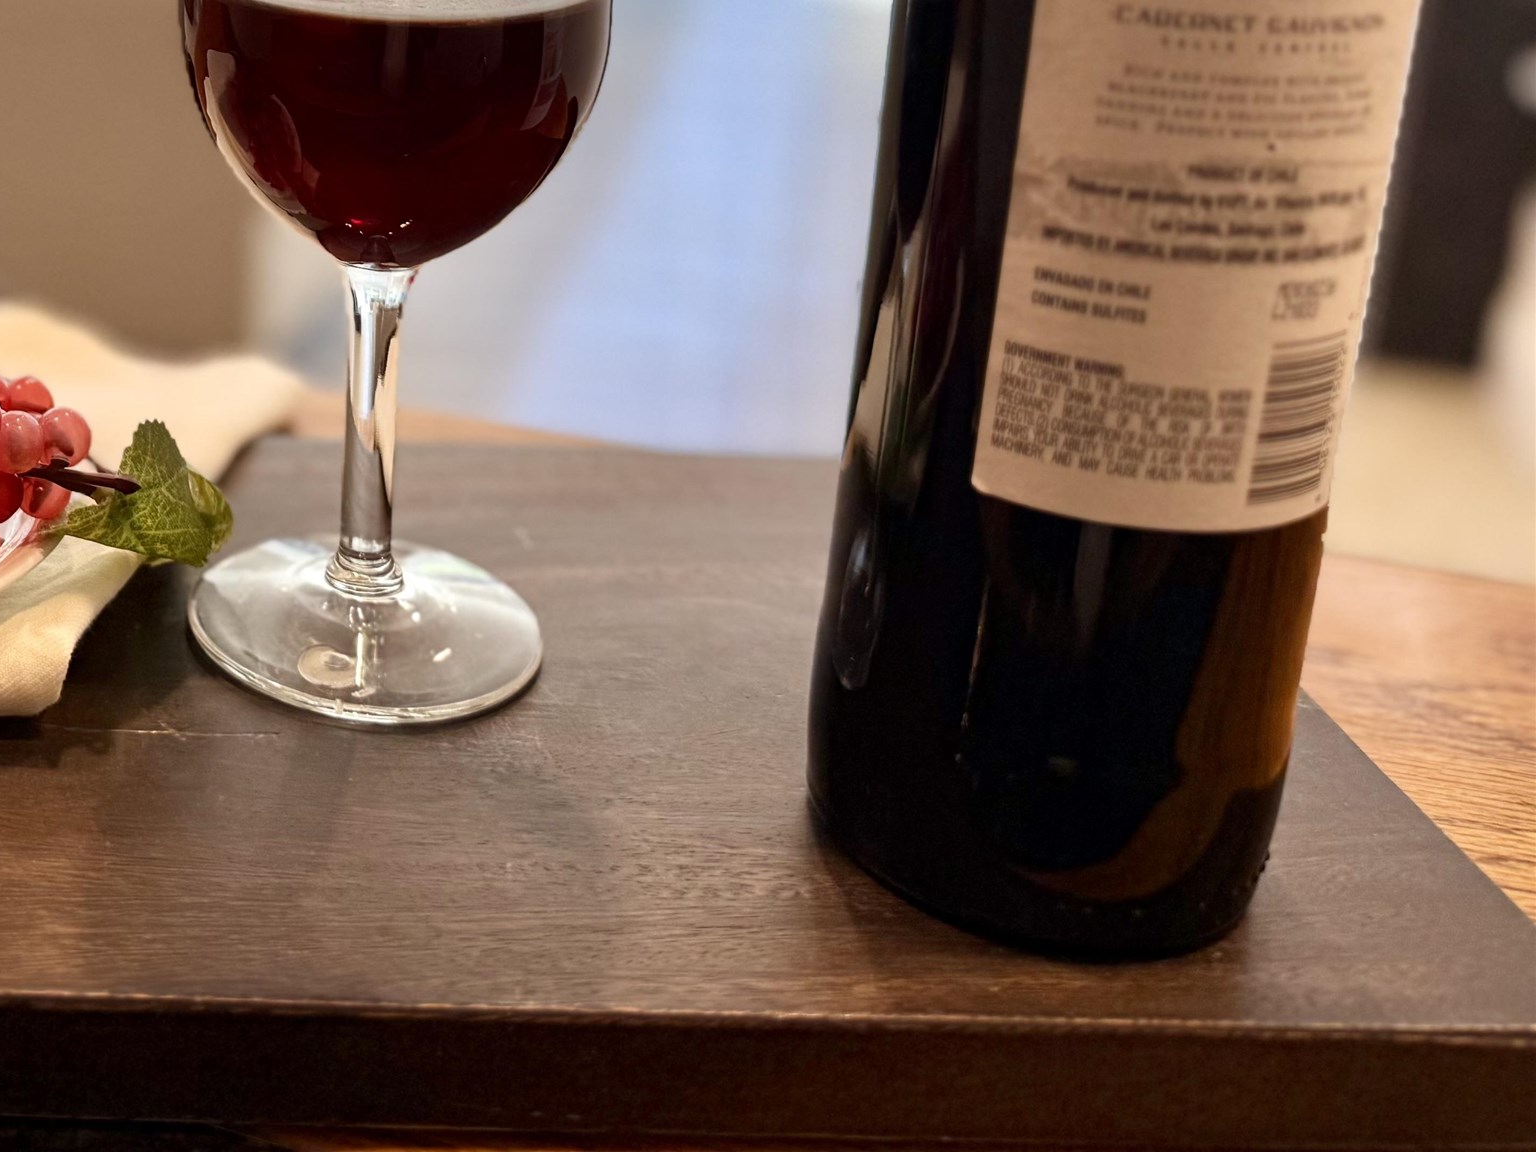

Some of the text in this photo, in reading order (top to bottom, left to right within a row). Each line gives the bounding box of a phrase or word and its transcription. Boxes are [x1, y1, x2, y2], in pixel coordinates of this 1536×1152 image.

[1034, 266, 1152, 301] ENVASADO EN CHILE
[1031, 290, 1147, 325] CONTAINS SULFITES
[1005, 340, 1071, 367] GOVERNMENT
[1000, 372, 1036, 393] SHOULD
[1040, 384, 1060, 398] NOT
[1018, 360, 1073, 385] ACCORDING
[1078, 373, 1090, 389] TO
[997, 386, 1053, 413] PREGNANCY
[993, 417, 1029, 440] IMPAIRS
[1033, 429, 1059, 447] YOUR
[1063, 435, 1098, 455] ABILITY
[1051, 417, 1121, 441] CONSUMPTION
[1051, 451, 1072, 467] AND
[1078, 455, 1100, 472] MAY
[1106, 462, 1139, 479] CAUSE
